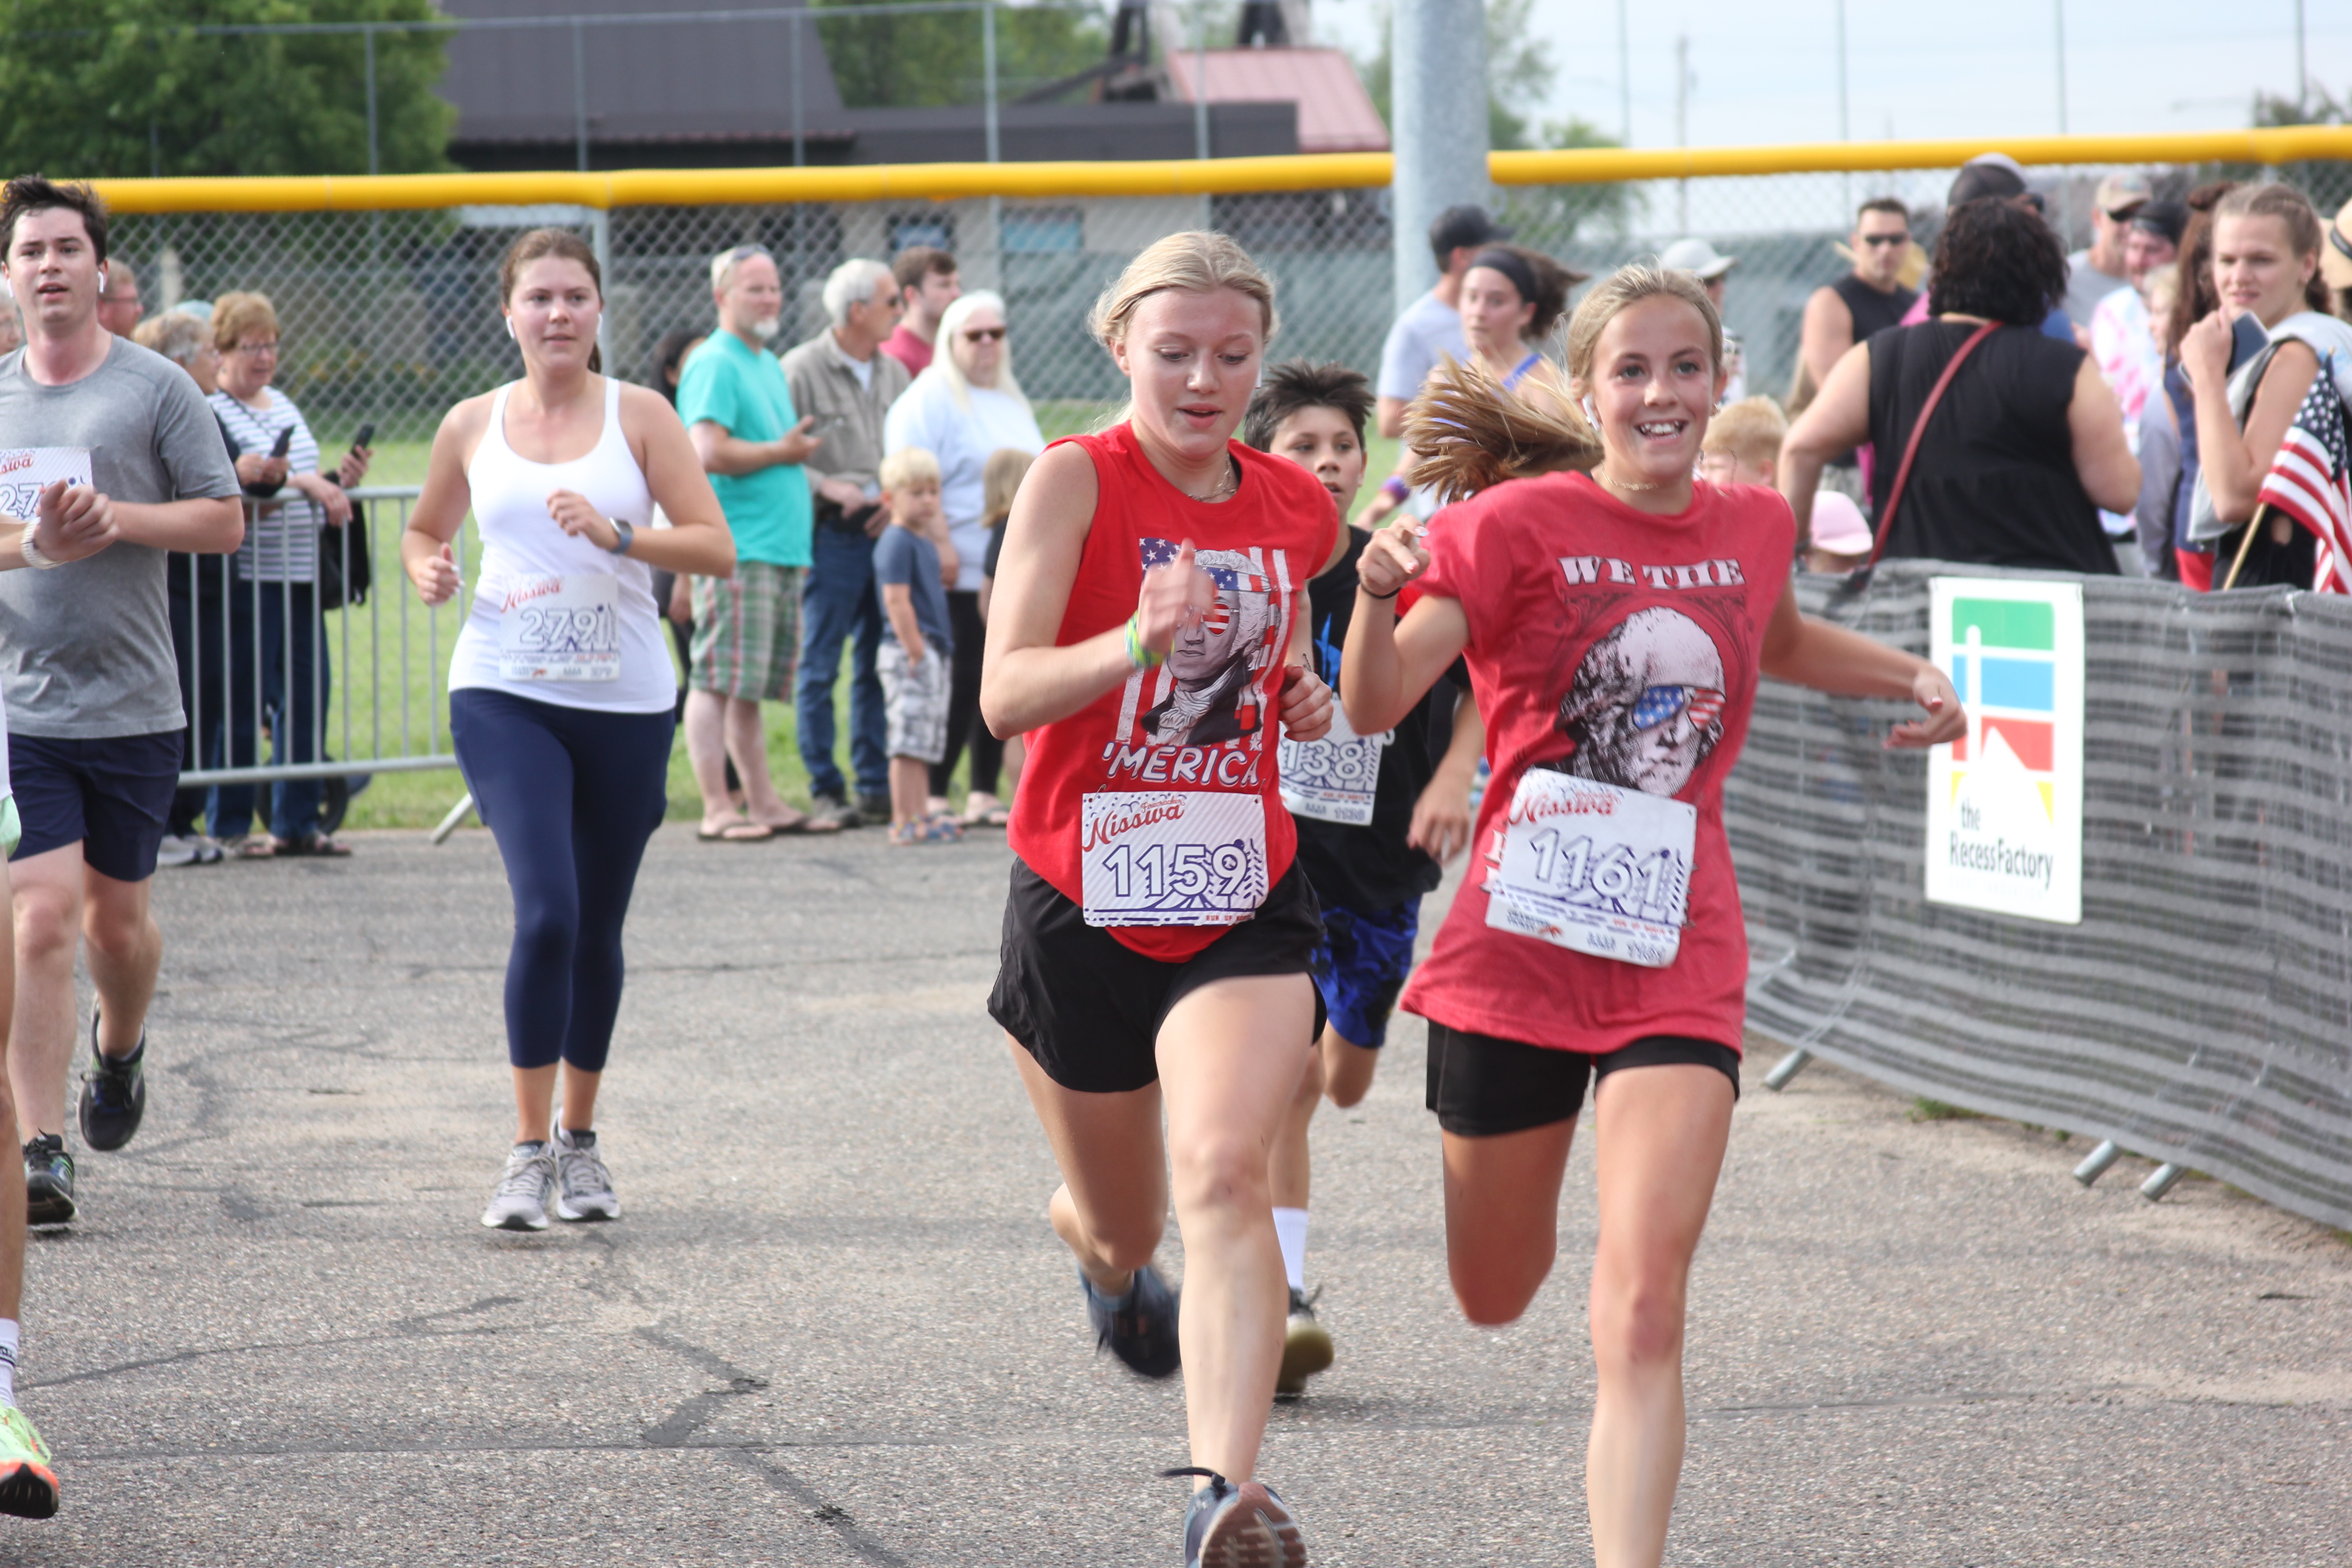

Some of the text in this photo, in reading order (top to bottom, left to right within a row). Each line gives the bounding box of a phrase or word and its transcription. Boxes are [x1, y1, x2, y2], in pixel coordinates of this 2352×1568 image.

[1558, 555, 1746, 590] WE THE
[520, 607, 617, 643] 2791
[1102, 741, 1263, 787] 'MERICA
[1280, 738, 1364, 780] 138
[1083, 804, 1185, 853] Nisswa
[1960, 797, 1980, 831] the
[1102, 844, 1249, 897] 1159
[1529, 827, 1666, 907] 1161
[1950, 830, 2053, 892] RecessFactory
